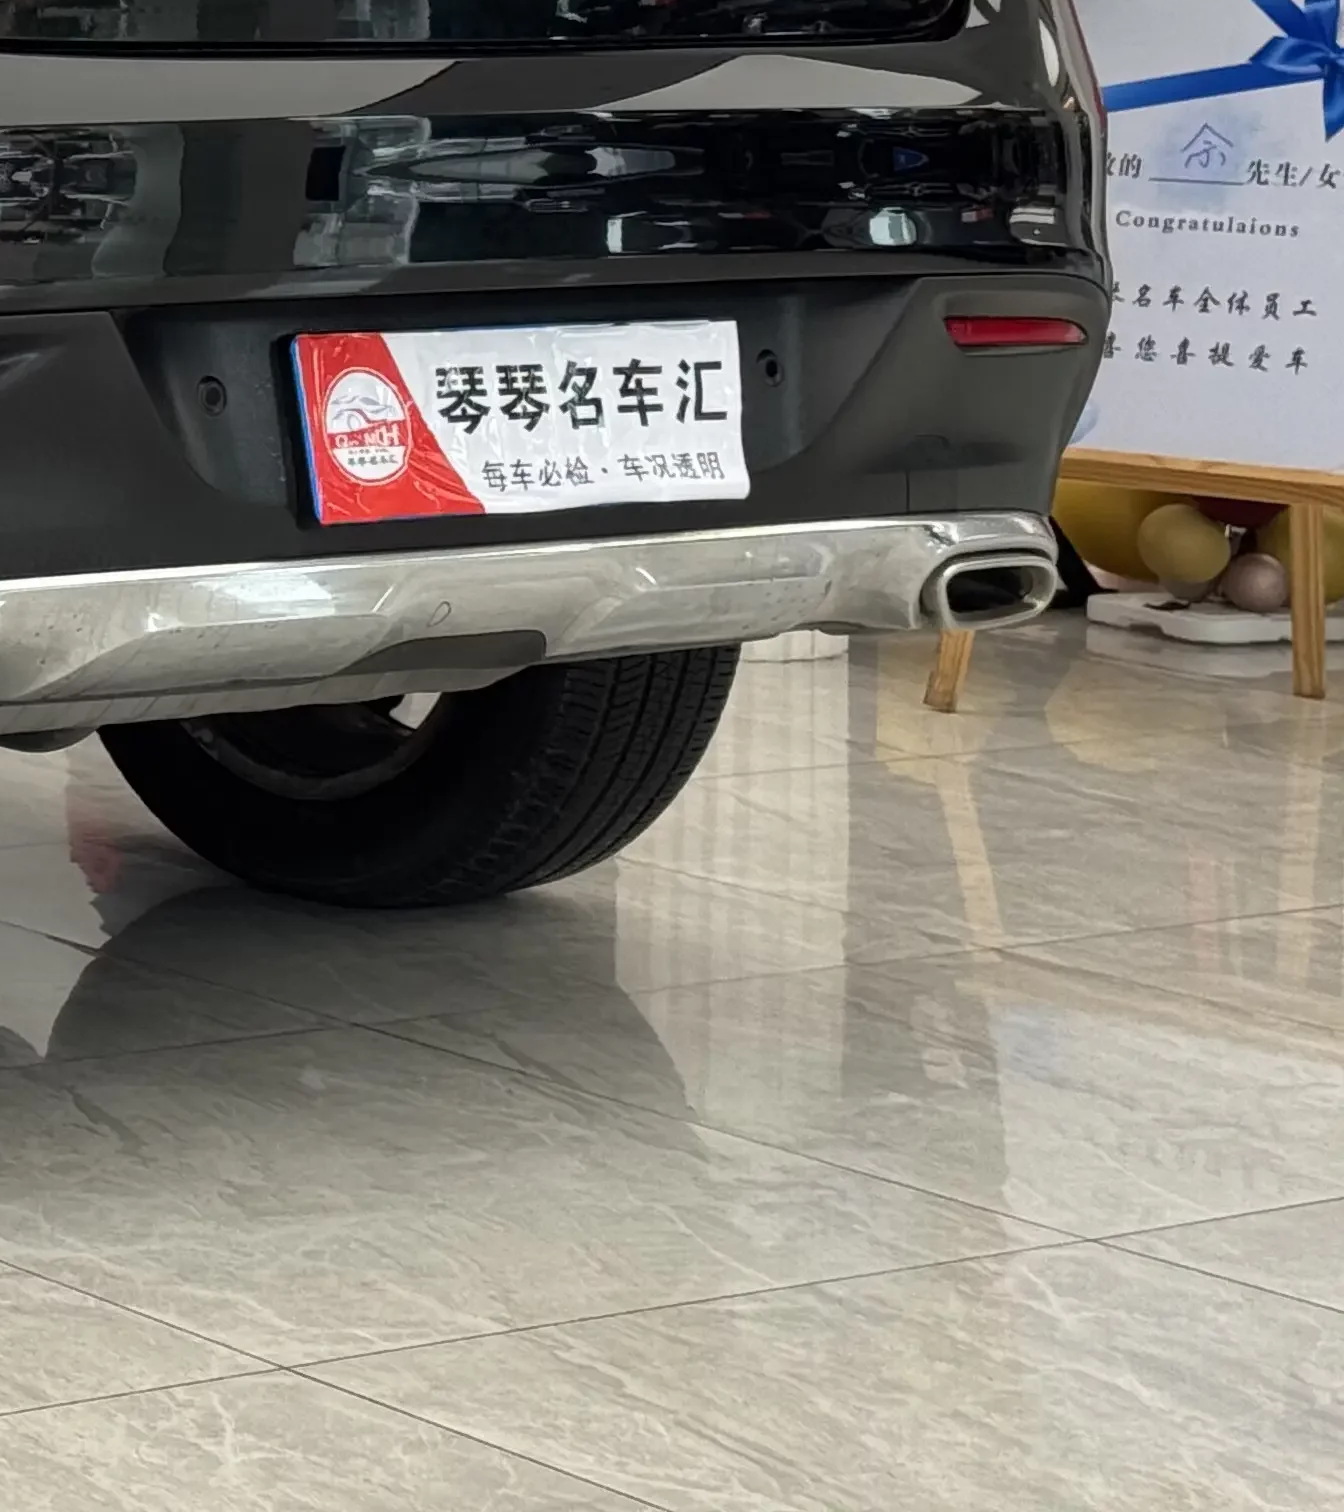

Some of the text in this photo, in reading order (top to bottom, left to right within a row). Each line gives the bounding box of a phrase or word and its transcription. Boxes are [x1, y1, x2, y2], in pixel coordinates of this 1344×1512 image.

[1247, 158, 1344, 190] 先生/女
[435, 358, 729, 434] 琴琴名车汇
